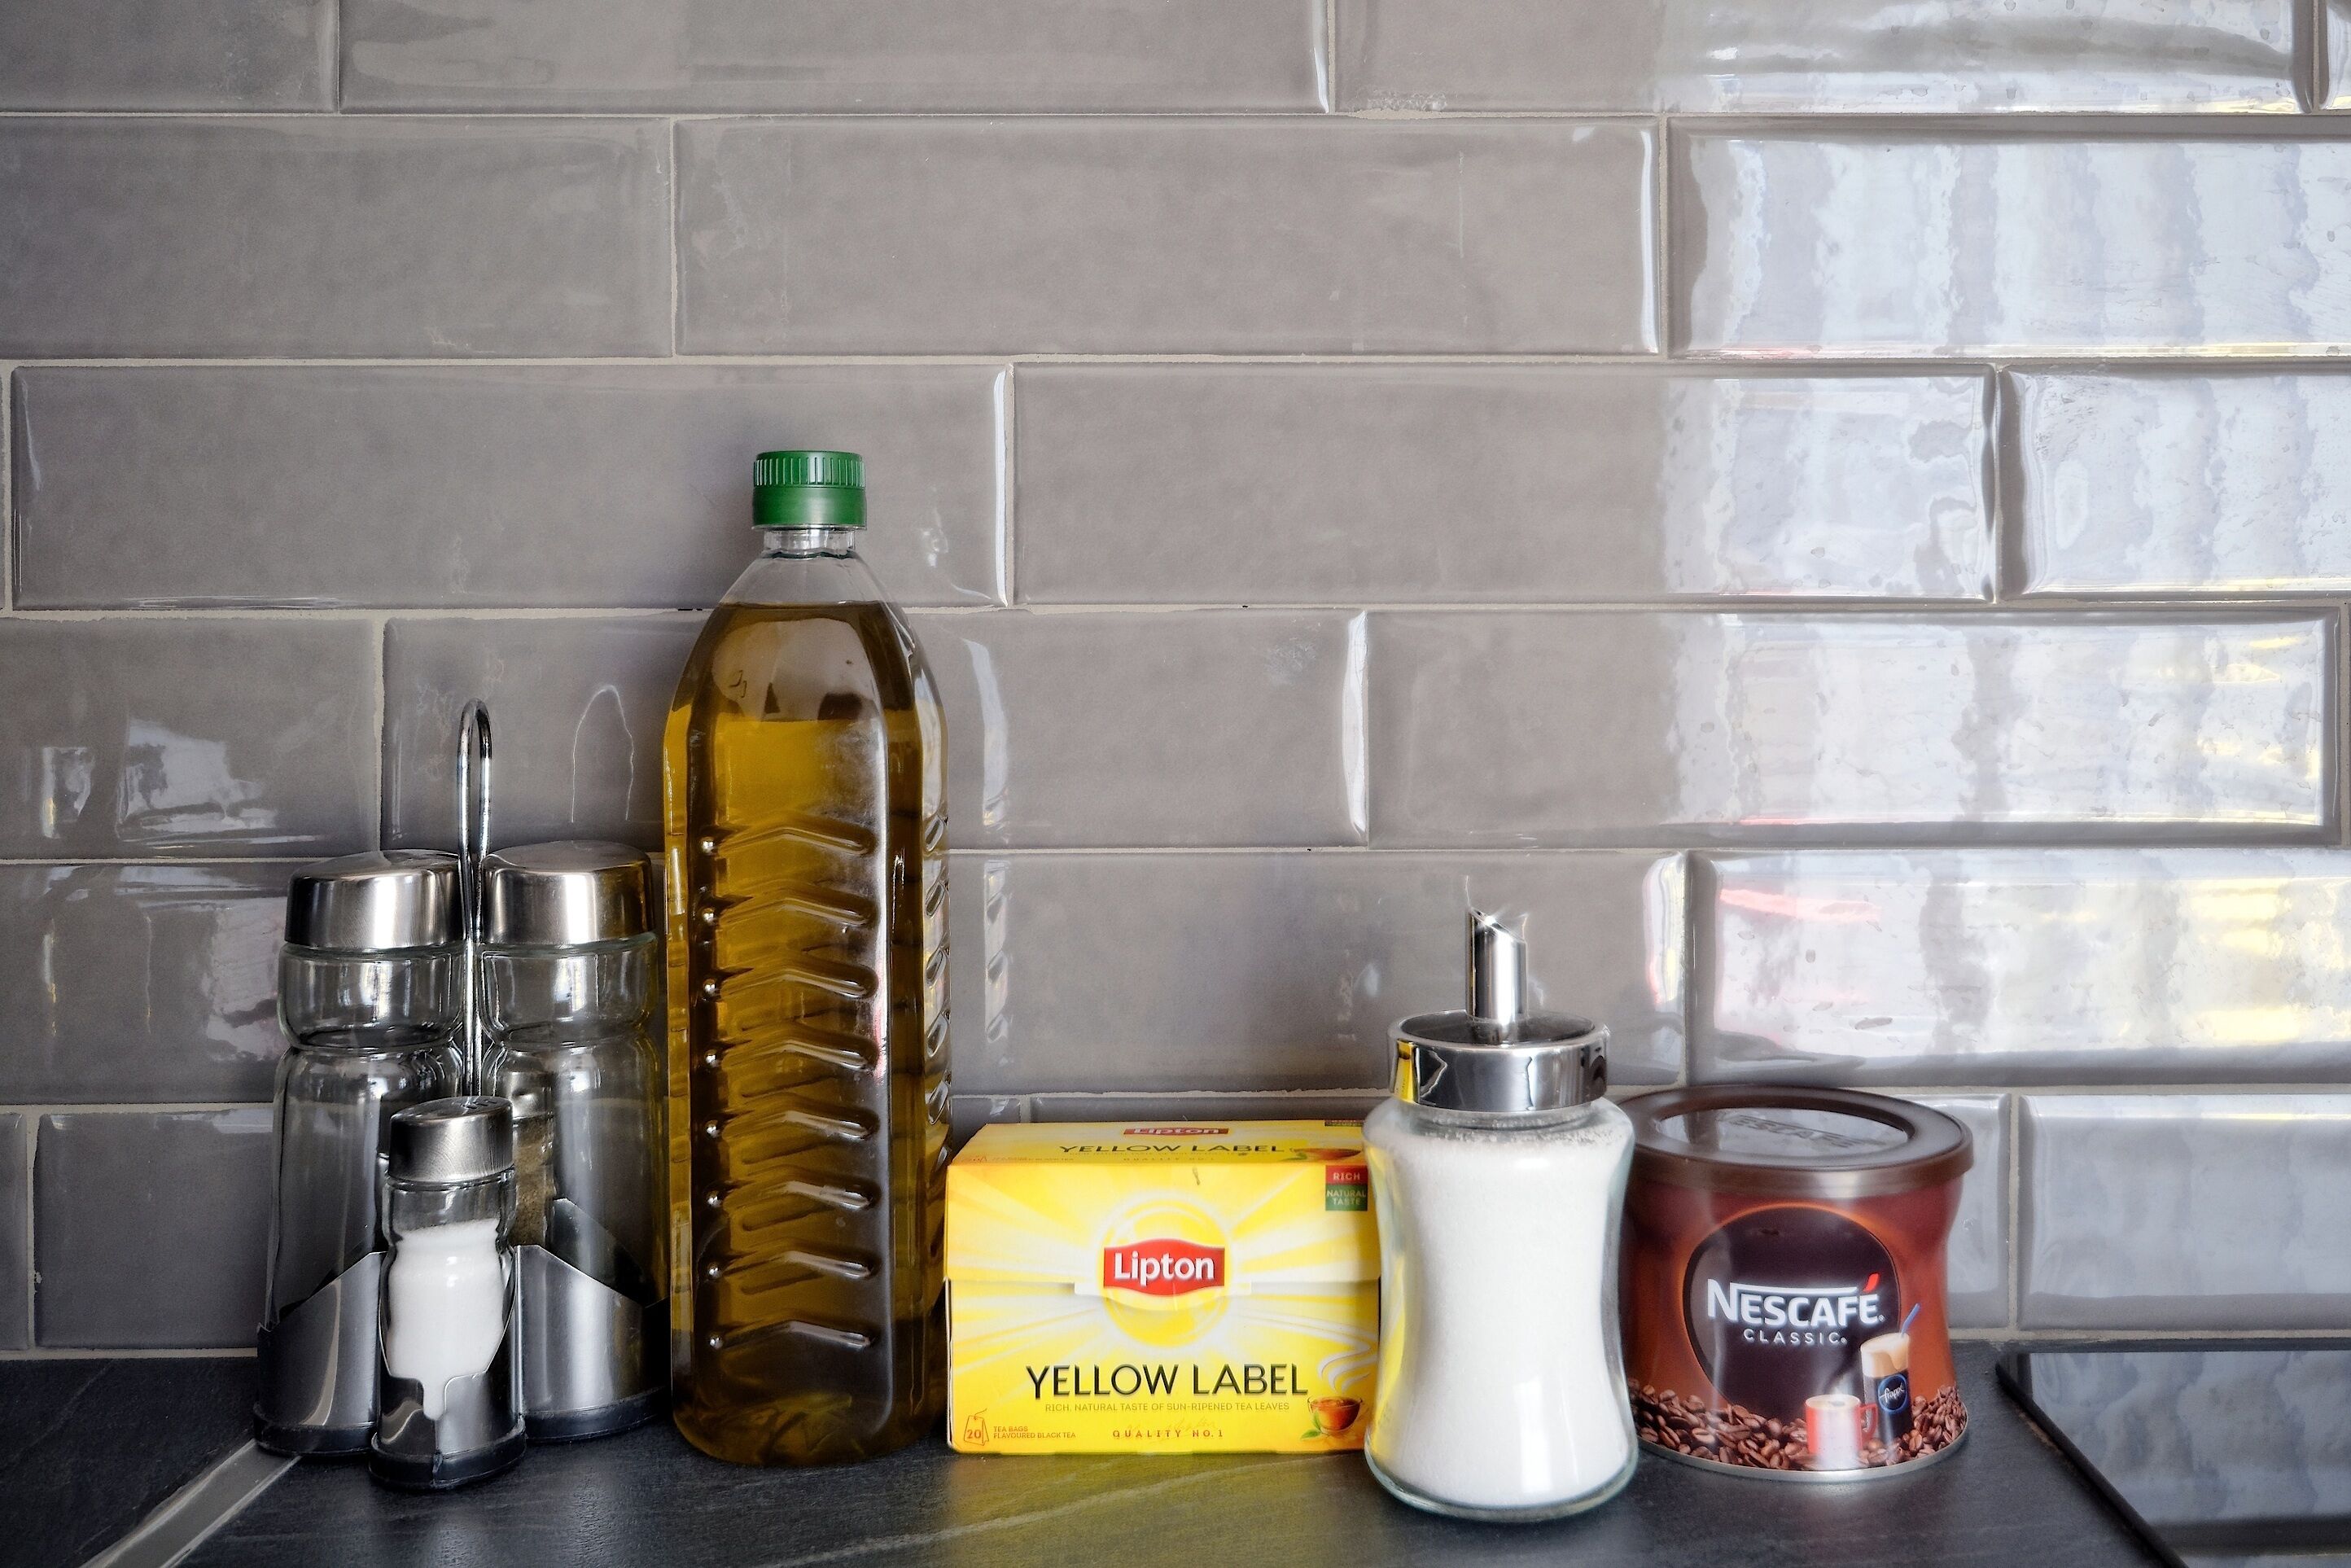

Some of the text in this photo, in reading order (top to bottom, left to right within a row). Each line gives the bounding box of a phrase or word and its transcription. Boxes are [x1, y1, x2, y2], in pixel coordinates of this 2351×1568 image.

[1333, 1172, 1360, 1180] RICH
[1332, 1198, 1361, 1206] TASTE
[1114, 1250, 1215, 1286] Lipton
[1707, 1272, 1880, 1327] NESCAFÉ
[1743, 1328, 1841, 1343] CLASSIC
[1026, 1363, 1309, 1399] YELLOW LABEL
[1075, 1403, 1119, 1412] NATURAL
[1120, 1403, 1148, 1411] TASTE
[1151, 1403, 1164, 1411] OF
[1167, 1402, 1232, 1411] SUN-RIPENED
[1236, 1402, 1253, 1411] TEA
[1255, 1402, 1289, 1410] LEAVES
[966, 1429, 982, 1439] 20
[1112, 1430, 1182, 1439] QUALITY
